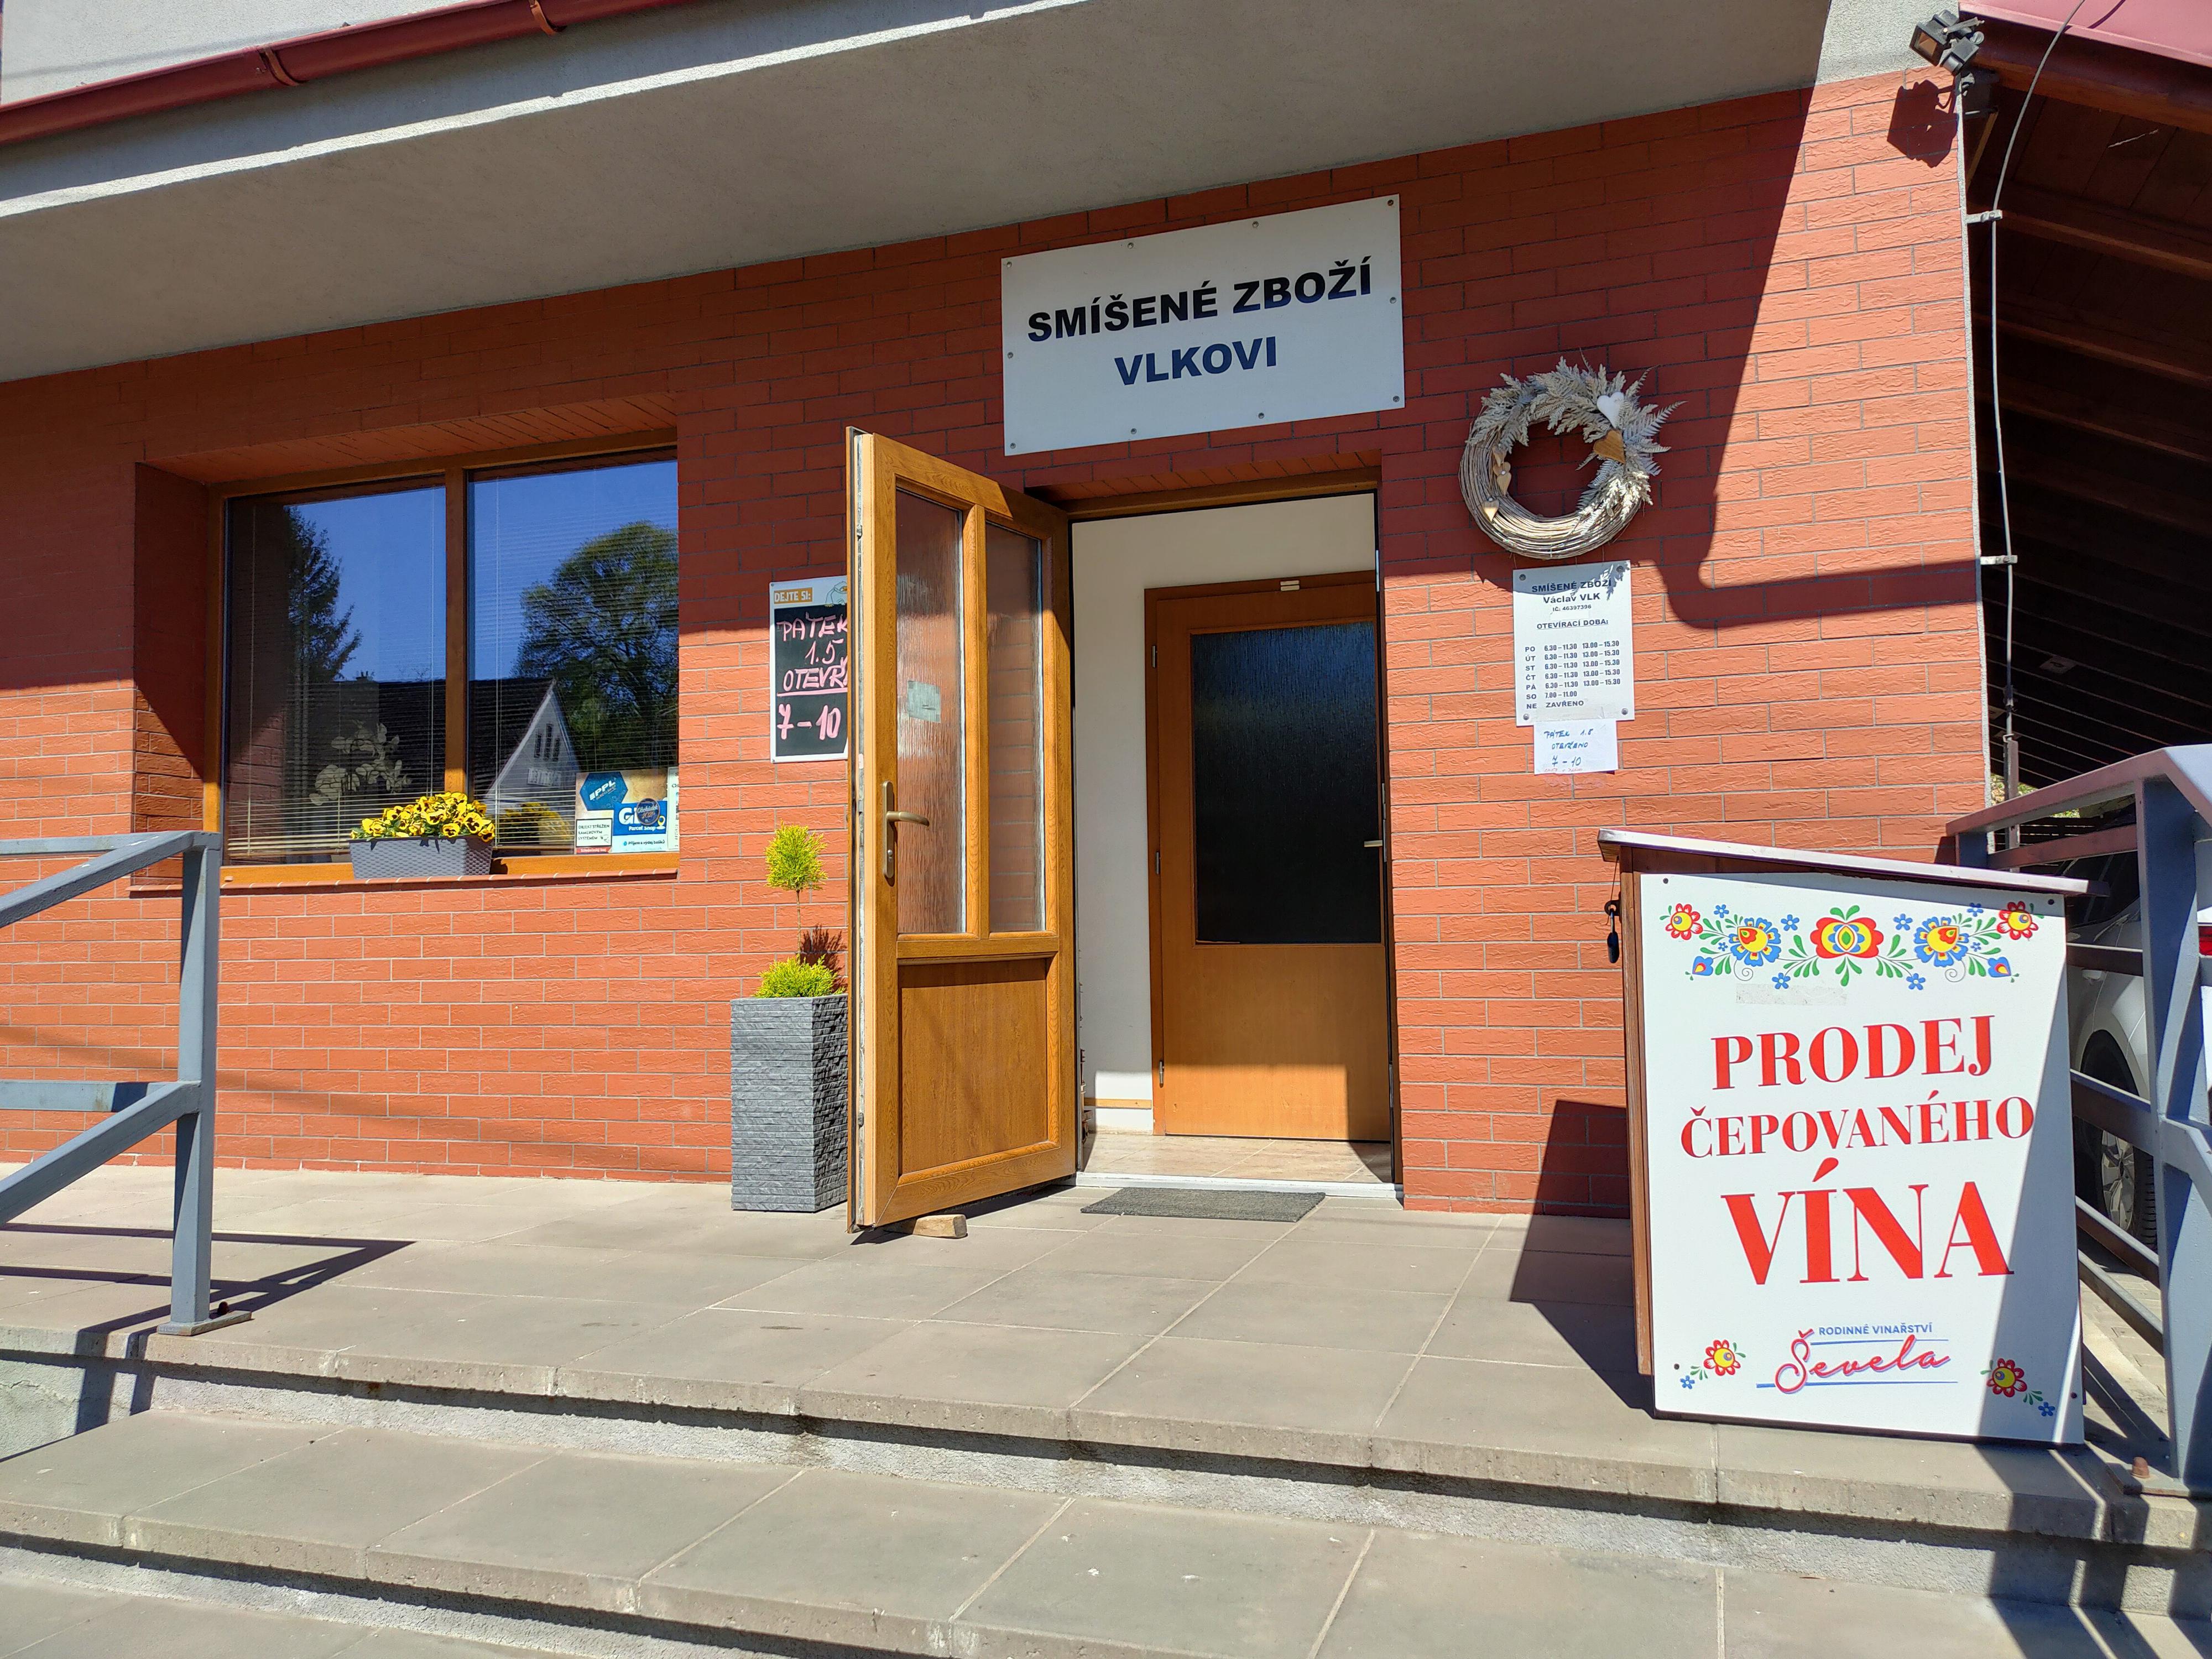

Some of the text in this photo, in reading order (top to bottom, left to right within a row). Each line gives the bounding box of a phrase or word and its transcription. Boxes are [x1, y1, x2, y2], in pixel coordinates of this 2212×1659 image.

[1027, 255, 1371, 342] SMÍŠENÉ ZBOŽÍ
[1114, 336, 1277, 385] VLKOVI
[775, 591, 811, 602] DEJTE SI:
[1532, 581, 1576, 592] SMÍŠENÉ
[1543, 592, 1600, 604] Václav VLK
[1537, 619, 1580, 629] OTEVÍRACÍ
[595, 780, 615, 796] PPL
[1711, 1015, 1995, 1091] PRODEJ
[1681, 1089, 2035, 1159] ČEPOVANÉHO
[1720, 1157, 2015, 1286] VÍNA
[1819, 1322, 1933, 1335] RODINNÉ VINAŘSTVÍ
[1775, 1328, 1951, 1394] Ševela
